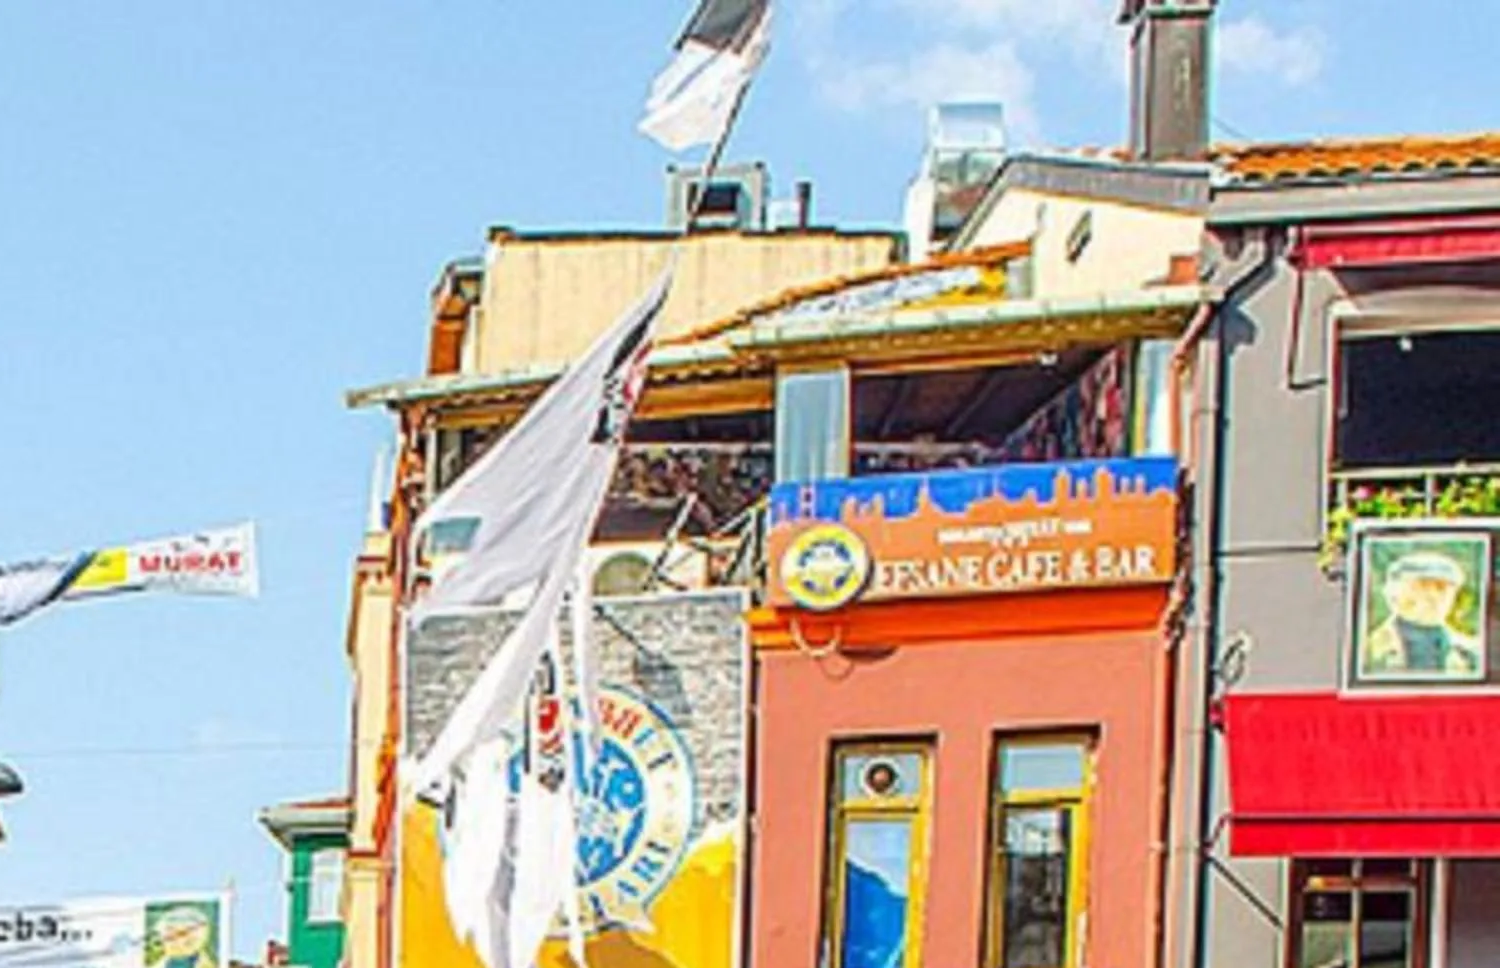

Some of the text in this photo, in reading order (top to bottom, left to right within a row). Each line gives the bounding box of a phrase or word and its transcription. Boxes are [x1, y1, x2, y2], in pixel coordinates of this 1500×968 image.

[138, 551, 242, 577] MURAT
[987, 550, 1062, 584] CAFE
[1096, 546, 1155, 578] BAR
